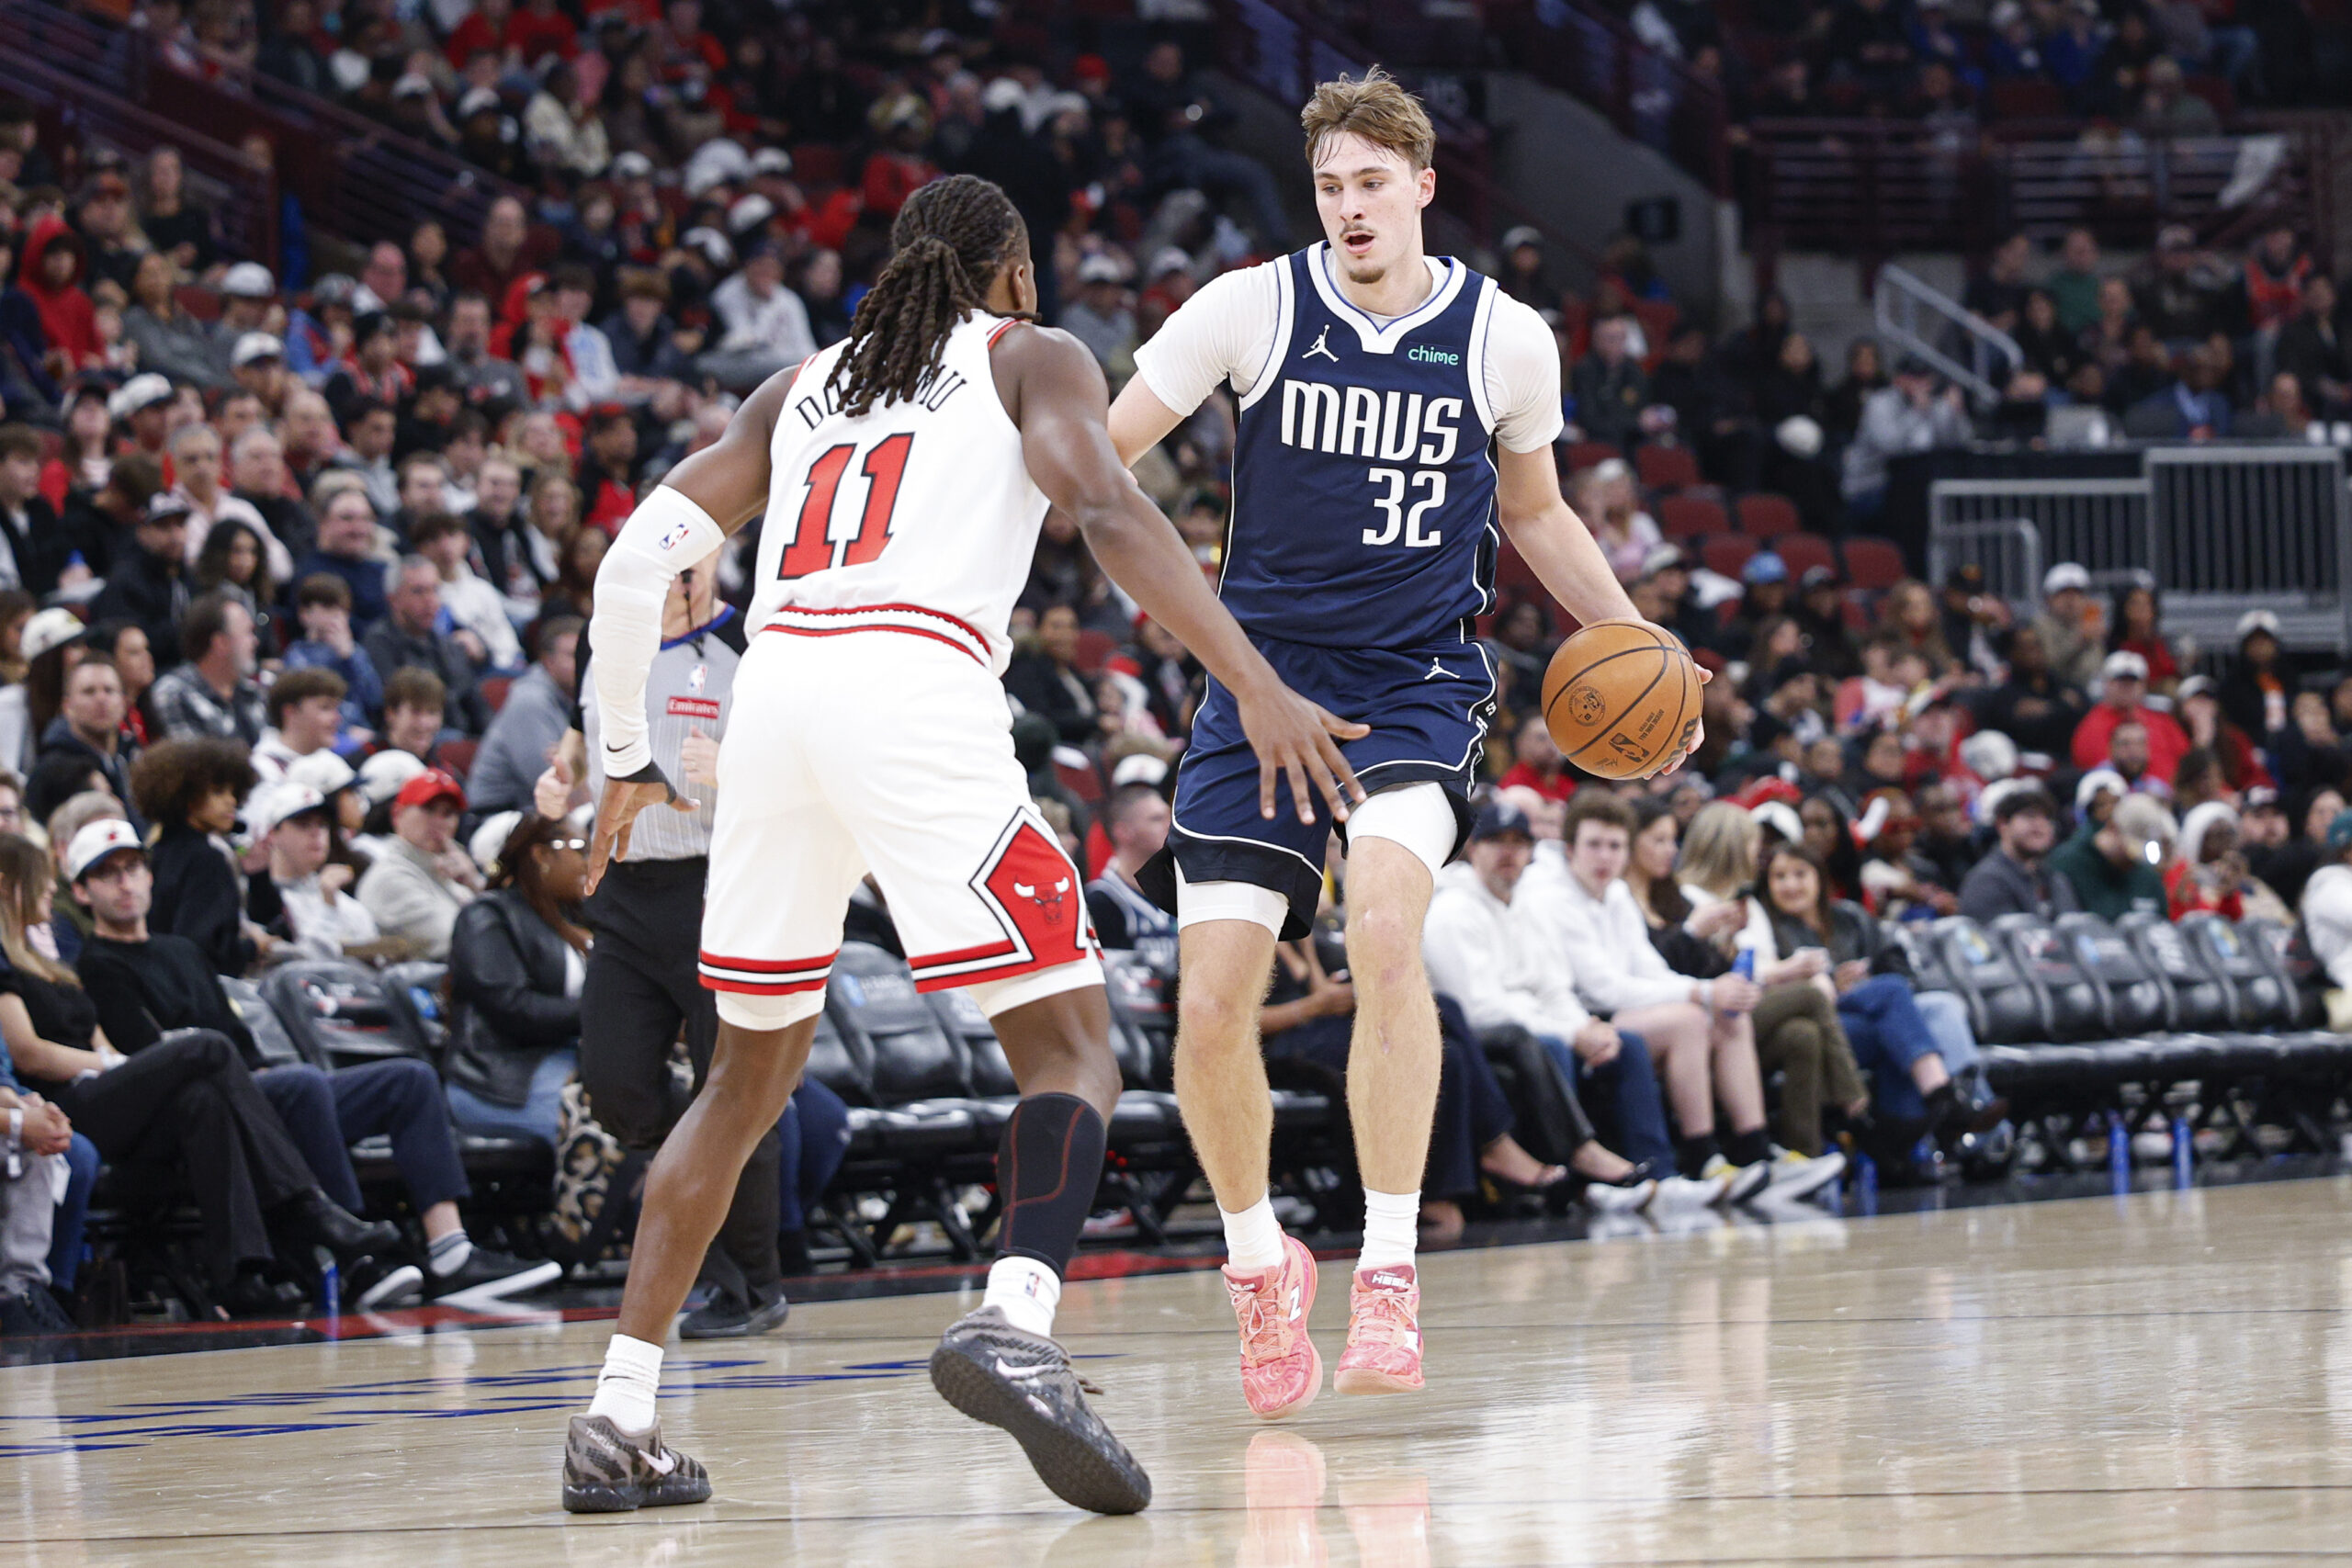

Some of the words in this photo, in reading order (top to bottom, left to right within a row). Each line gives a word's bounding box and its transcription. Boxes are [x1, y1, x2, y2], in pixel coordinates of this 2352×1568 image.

[1408, 345, 1459, 366] chime
[1282, 378, 1463, 466] MAVS
[776, 432, 916, 581] 11
[1363, 467, 1447, 547] 32
[668, 698, 719, 715] Emirates
